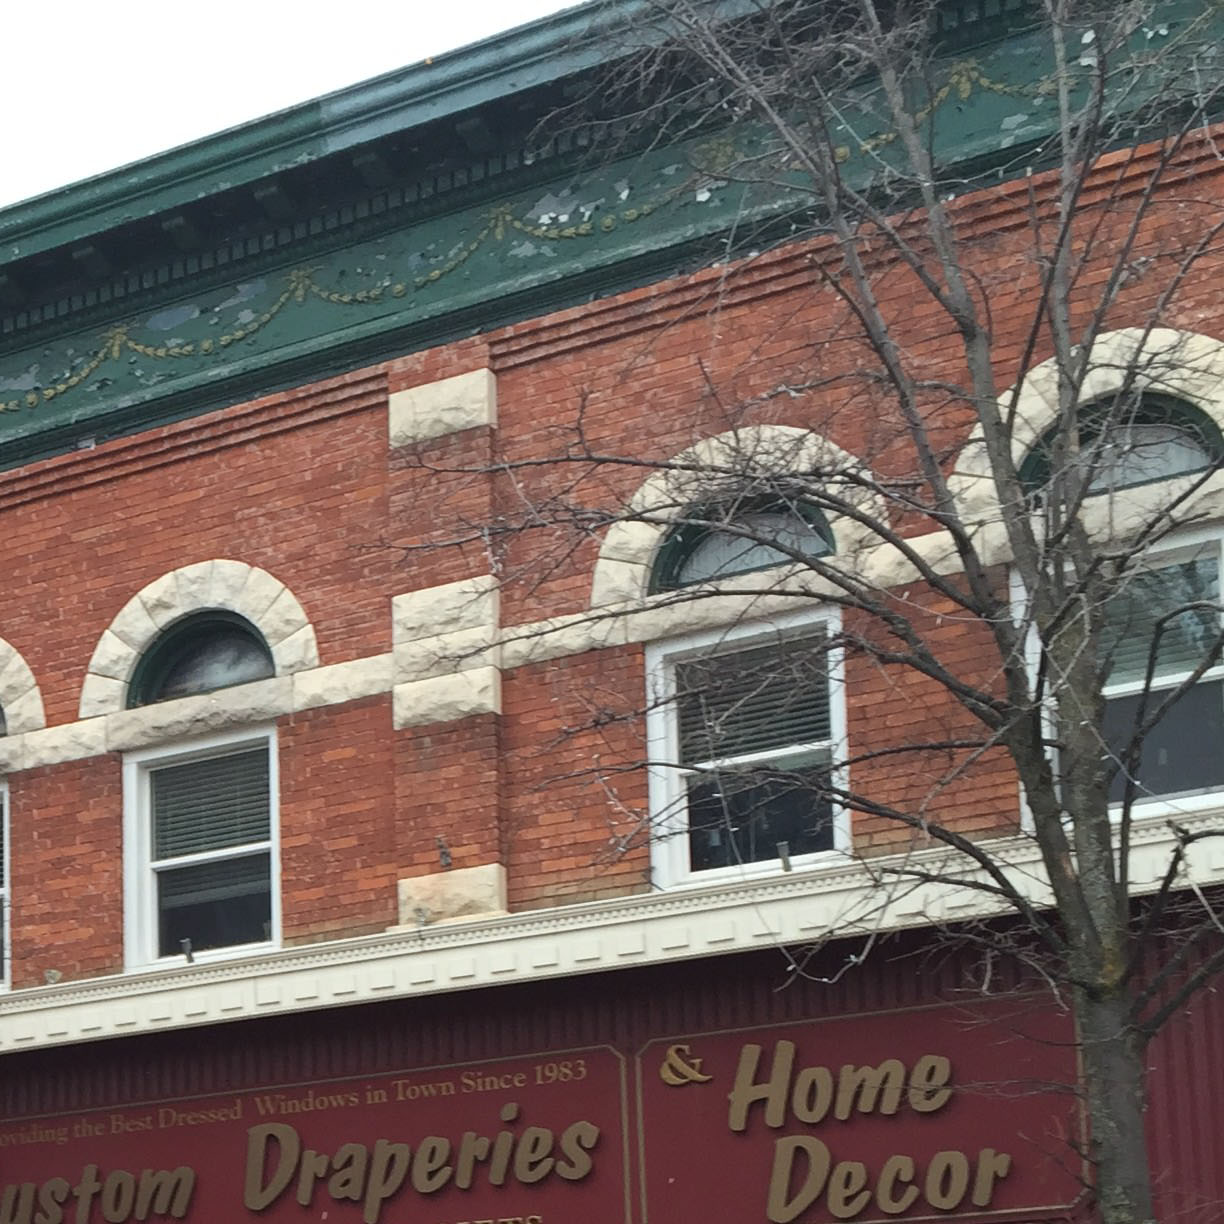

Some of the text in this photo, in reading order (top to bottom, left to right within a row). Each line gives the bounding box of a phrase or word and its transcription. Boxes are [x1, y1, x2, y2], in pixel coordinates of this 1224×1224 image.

[74, 1118, 105, 1138] the
[110, 1113, 153, 1136] Best
[159, 1100, 242, 1129] Dressed
[254, 1090, 360, 1117] Windows
[365, 1085, 389, 1105] in
[391, 1079, 456, 1102] Town
[461, 1069, 527, 1093] Since
[534, 1059, 588, 1085] 1983
[659, 1040, 953, 1132] & Home
[244, 1103, 600, 1224] Draperies
[766, 1135, 1012, 1224] Decor
